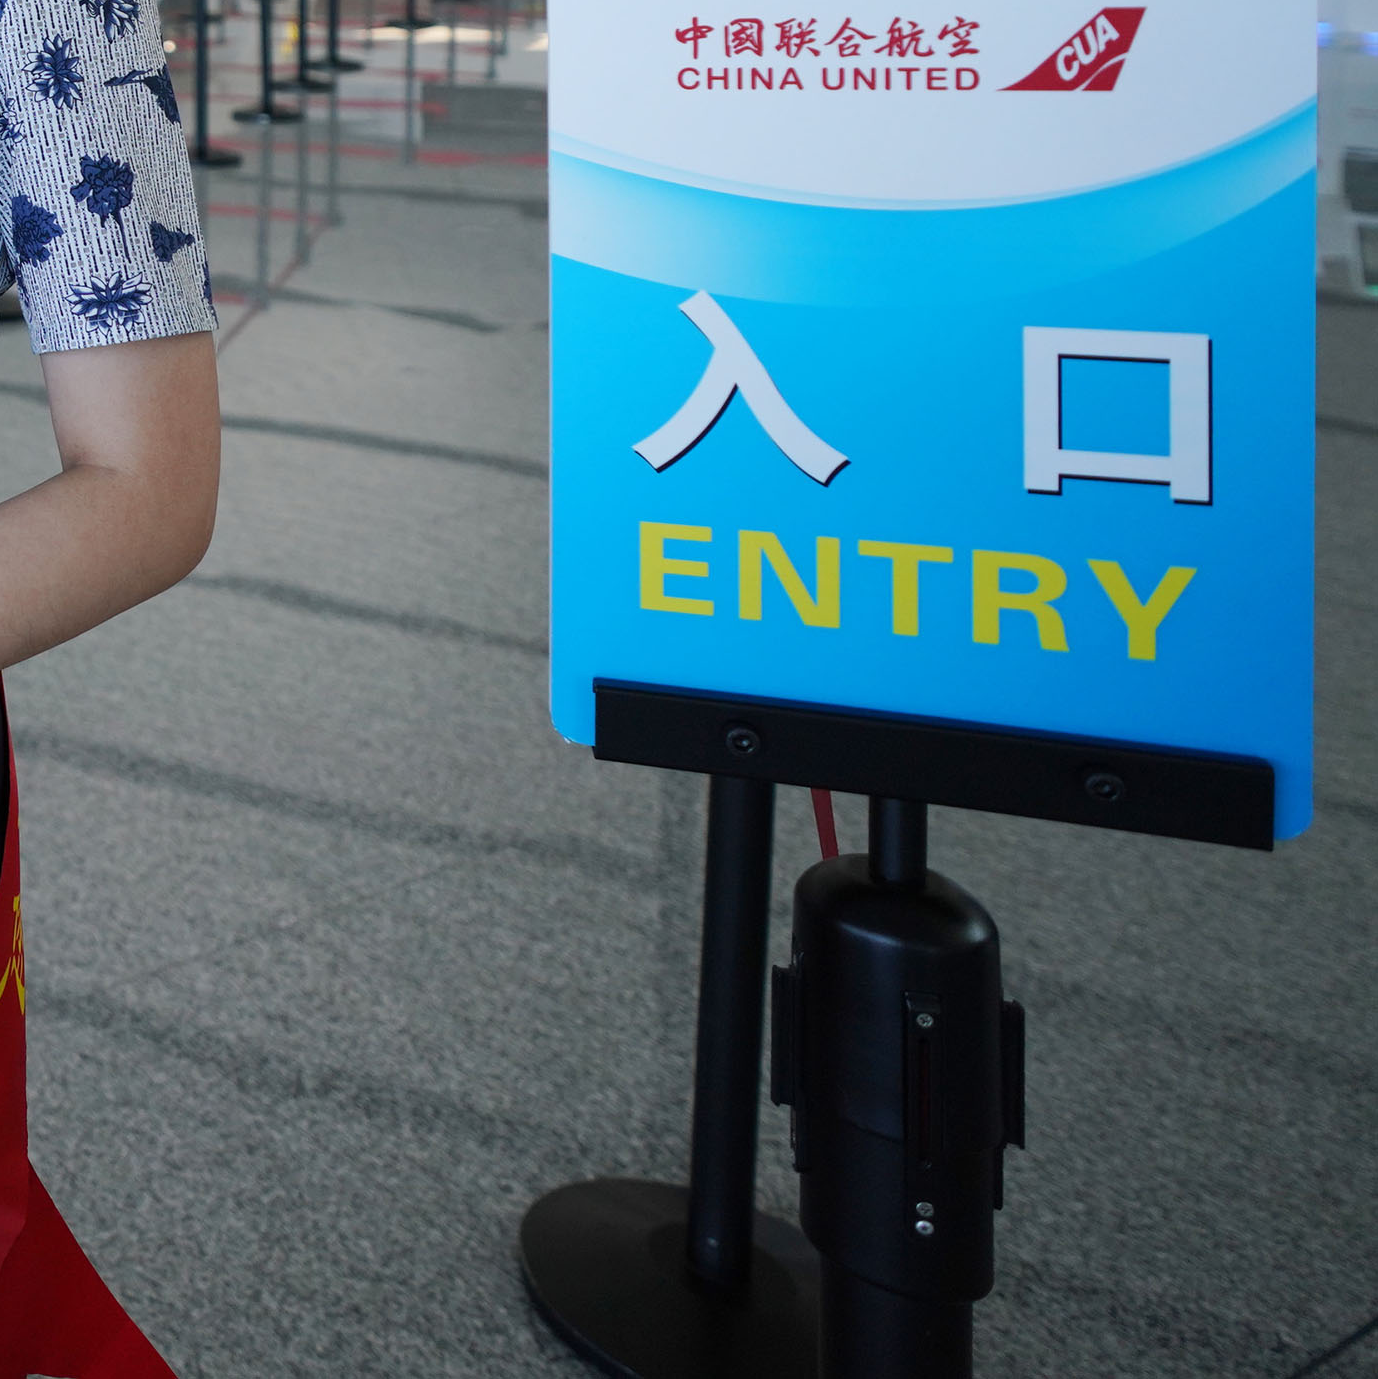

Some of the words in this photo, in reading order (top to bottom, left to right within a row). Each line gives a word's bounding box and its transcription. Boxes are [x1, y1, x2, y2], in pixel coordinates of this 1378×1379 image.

[676, 66, 804, 91] CHINA
[822, 66, 981, 91] UNITED
[1055, 13, 1122, 82] CUA
[631, 288, 1214, 506] 入口
[639, 520, 1199, 662] ENTRY
